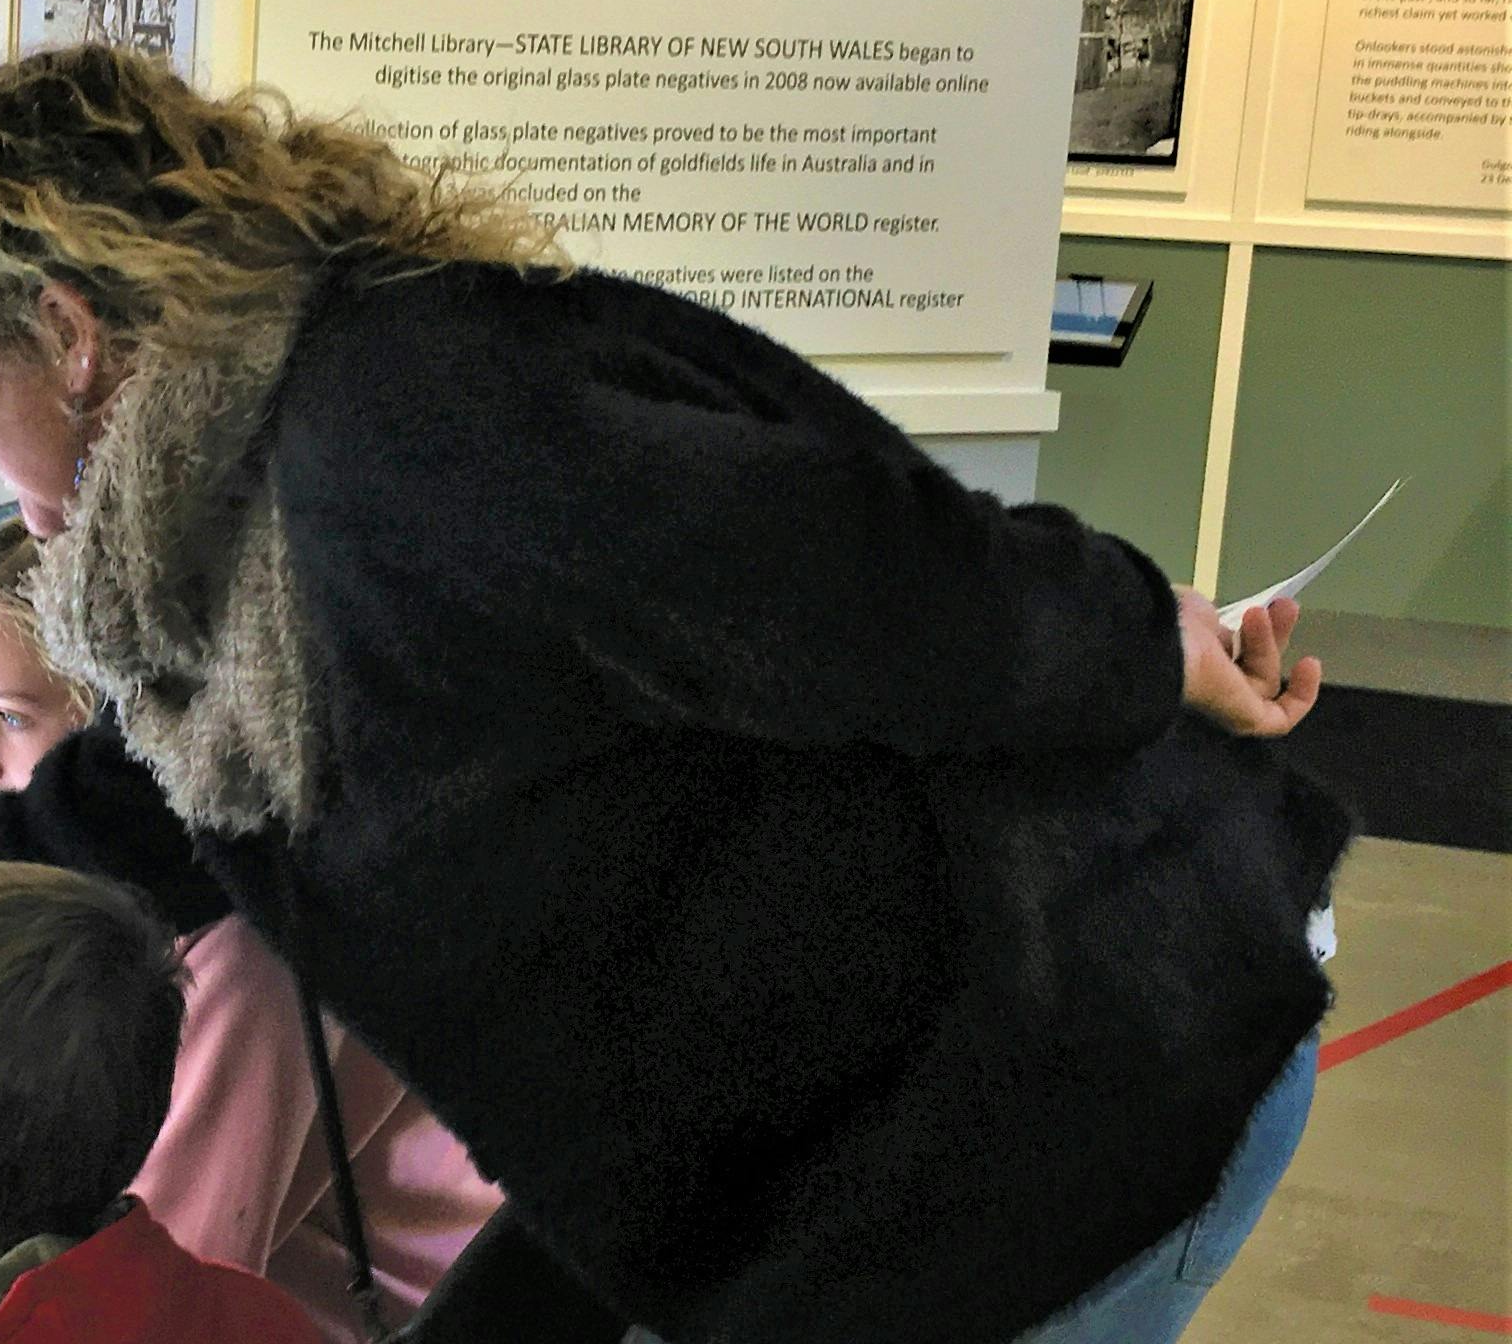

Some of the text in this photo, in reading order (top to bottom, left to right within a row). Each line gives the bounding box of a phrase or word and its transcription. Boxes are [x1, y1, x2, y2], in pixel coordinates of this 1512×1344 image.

[1346, 125, 1379, 139] riding
[624, 212, 939, 236] MEMORY OF THE WORLD register.
